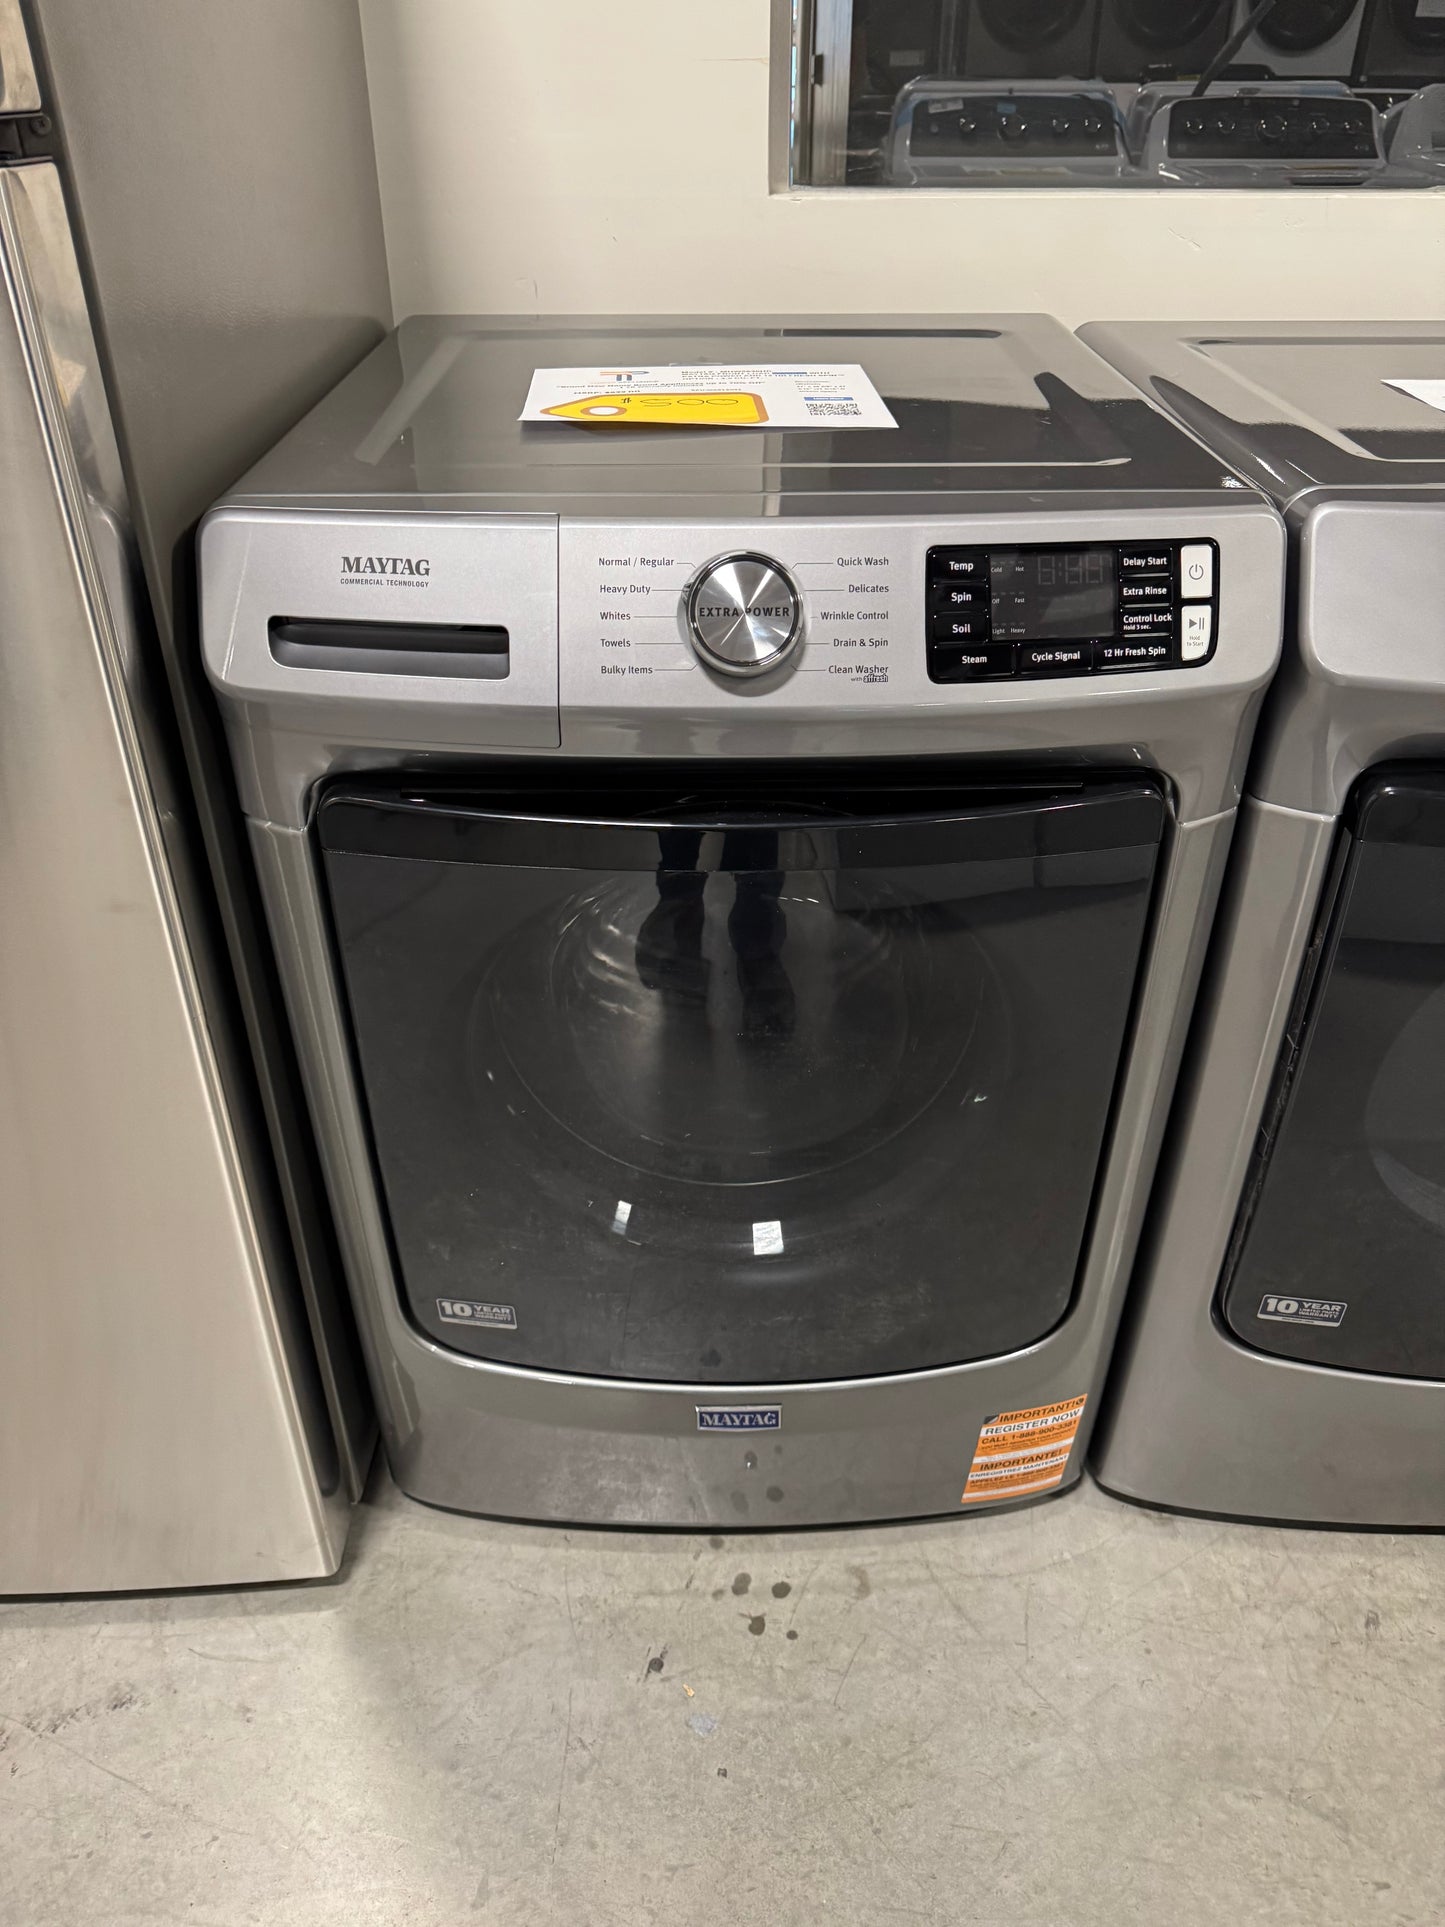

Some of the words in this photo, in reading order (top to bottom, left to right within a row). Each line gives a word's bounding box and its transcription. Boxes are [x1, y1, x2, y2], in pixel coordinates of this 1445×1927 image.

[341, 556, 430, 576] MAYTAG
[598, 557, 631, 566] Normal
[640, 558, 674, 568] Regular
[836, 557, 862, 567] Quick
[864, 557, 889, 566] Wash
[949, 561, 974, 572] Temp
[1123, 557, 1145, 567] Delay
[1147, 557, 1167, 565] Start
[386, 580, 429, 588] TECHNOLOGY
[848, 584, 889, 593] Delicates
[600, 585, 627, 595] Heavy
[629, 585, 651, 595] Duty
[1123, 587, 1143, 596] Extra
[1145, 586, 1167, 595] Rinse
[951, 592, 972, 603] Spin
[600, 611, 631, 621] Whites
[699, 607, 739, 617] EXTRA
[746, 607, 790, 617] POWER
[820, 611, 854, 620] Wrinkle
[856, 611, 889, 620] Control
[1123, 614, 1152, 624] Control
[1154, 614, 1172, 622] Lock
[952, 624, 971, 633] Soil
[600, 638, 631, 648] Towels
[833, 638, 857, 647] Drain
[859, 638, 866, 647] &
[868, 638, 888, 649] Spin
[1032, 652, 1052, 662] Cycle
[1055, 651, 1080, 661] Signal
[1104, 649, 1112, 657] 12
[1114, 648, 1123, 656] Hr
[1126, 647, 1146, 656] Fresh
[1148, 646, 1166, 656] Spin
[962, 655, 987, 664] Steam
[601, 665, 625, 676] Bulky
[628, 665, 653, 674] Items
[828, 665, 853, 674] Clean
[855, 665, 888, 674] Washer
[863, 673, 888, 683] affresh
[441, 1302, 472, 1317] 10
[474, 1305, 511, 1313] YEAR
[1267, 1298, 1299, 1314] 10
[1302, 1302, 1342, 1312] YEAR
[1000, 1401, 1075, 1423] IMPORTANT!
[702, 1413, 776, 1426] MAYTAG
[985, 1419, 1048, 1435] REGISTER
[1051, 1409, 1080, 1423] NOW
[981, 1435, 1008, 1445] CALL
[980, 1449, 1062, 1471] IMPORTANTE!
